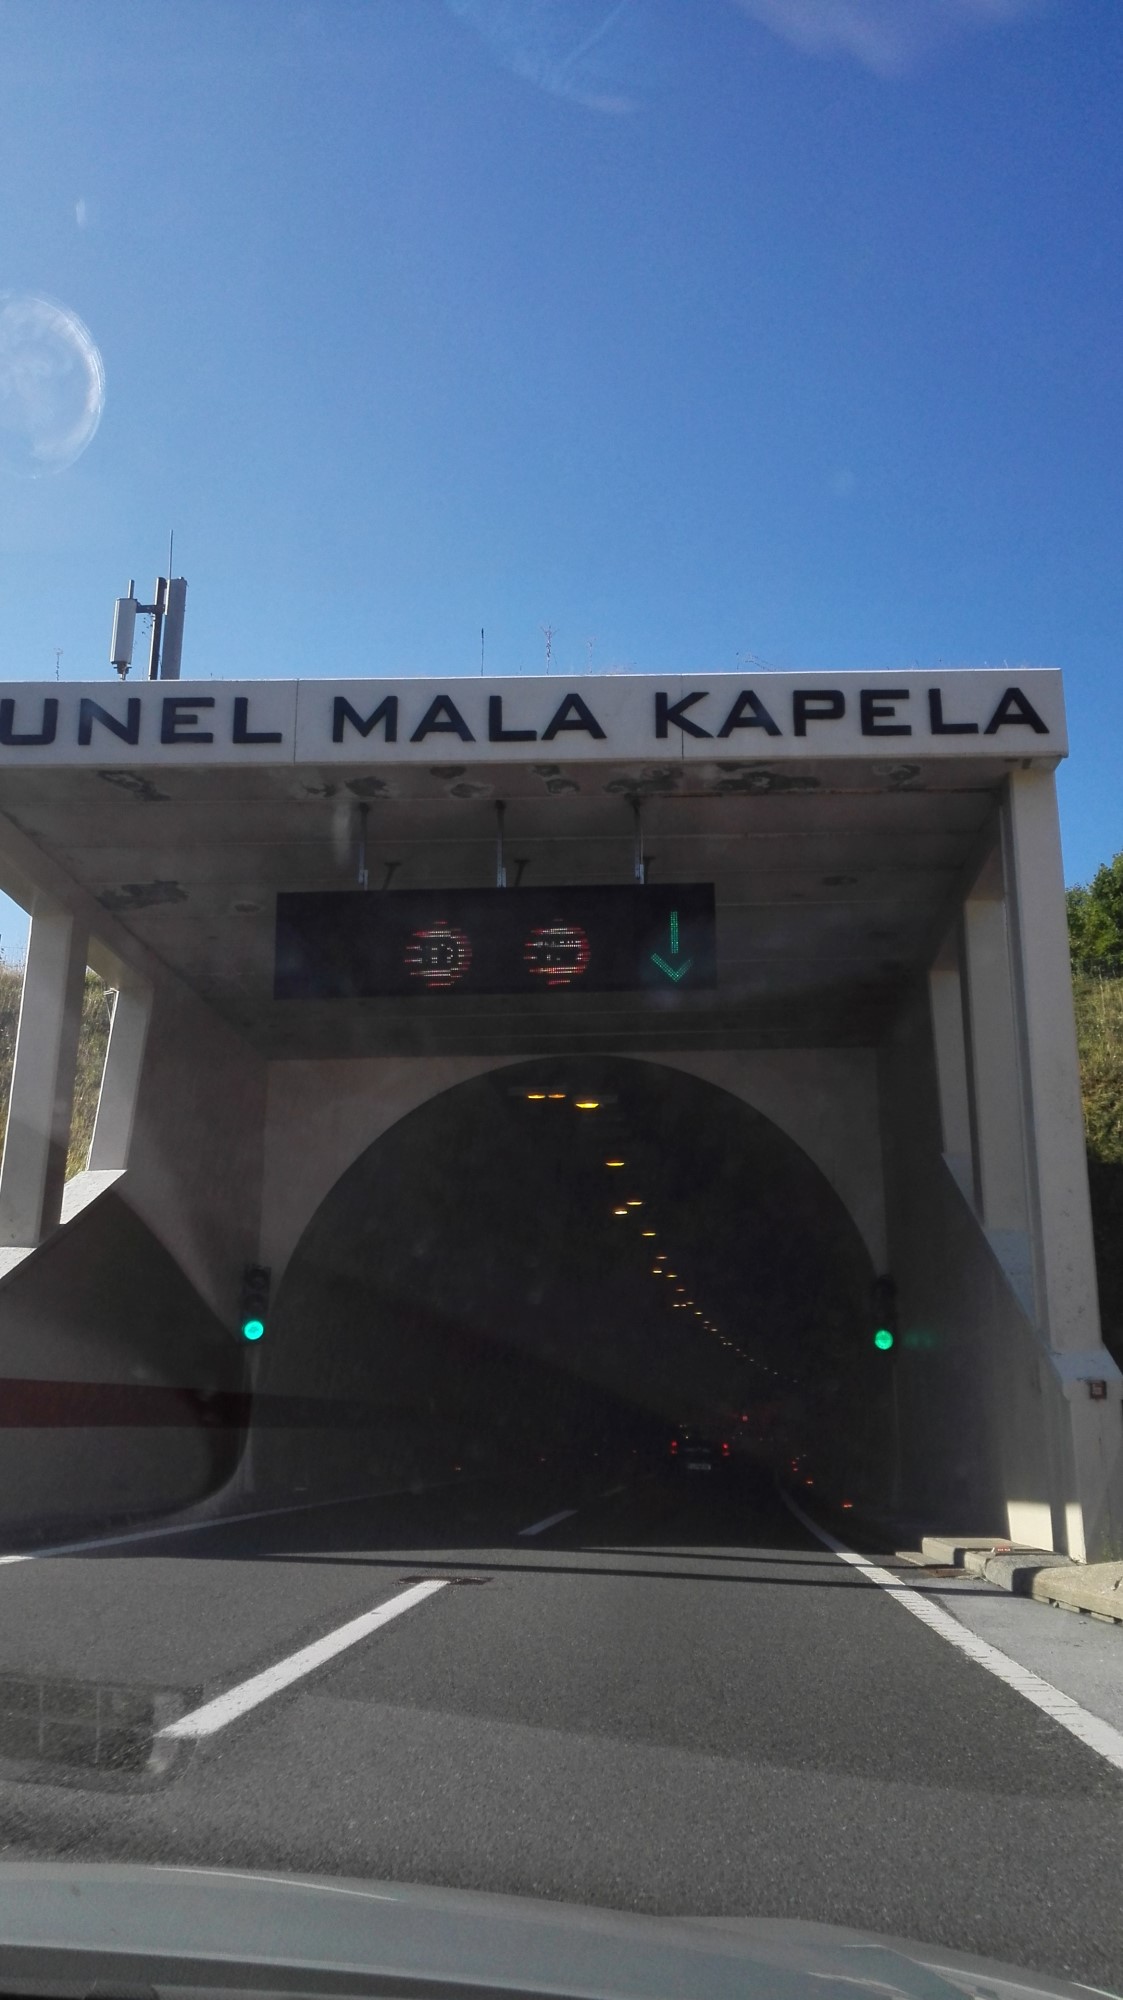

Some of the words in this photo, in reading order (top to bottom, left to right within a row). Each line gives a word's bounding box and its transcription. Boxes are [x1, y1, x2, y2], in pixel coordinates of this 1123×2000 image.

[0, 696, 283, 746] UNEL
[332, 694, 607, 743] MALA
[654, 687, 1050, 739] KAPELA
